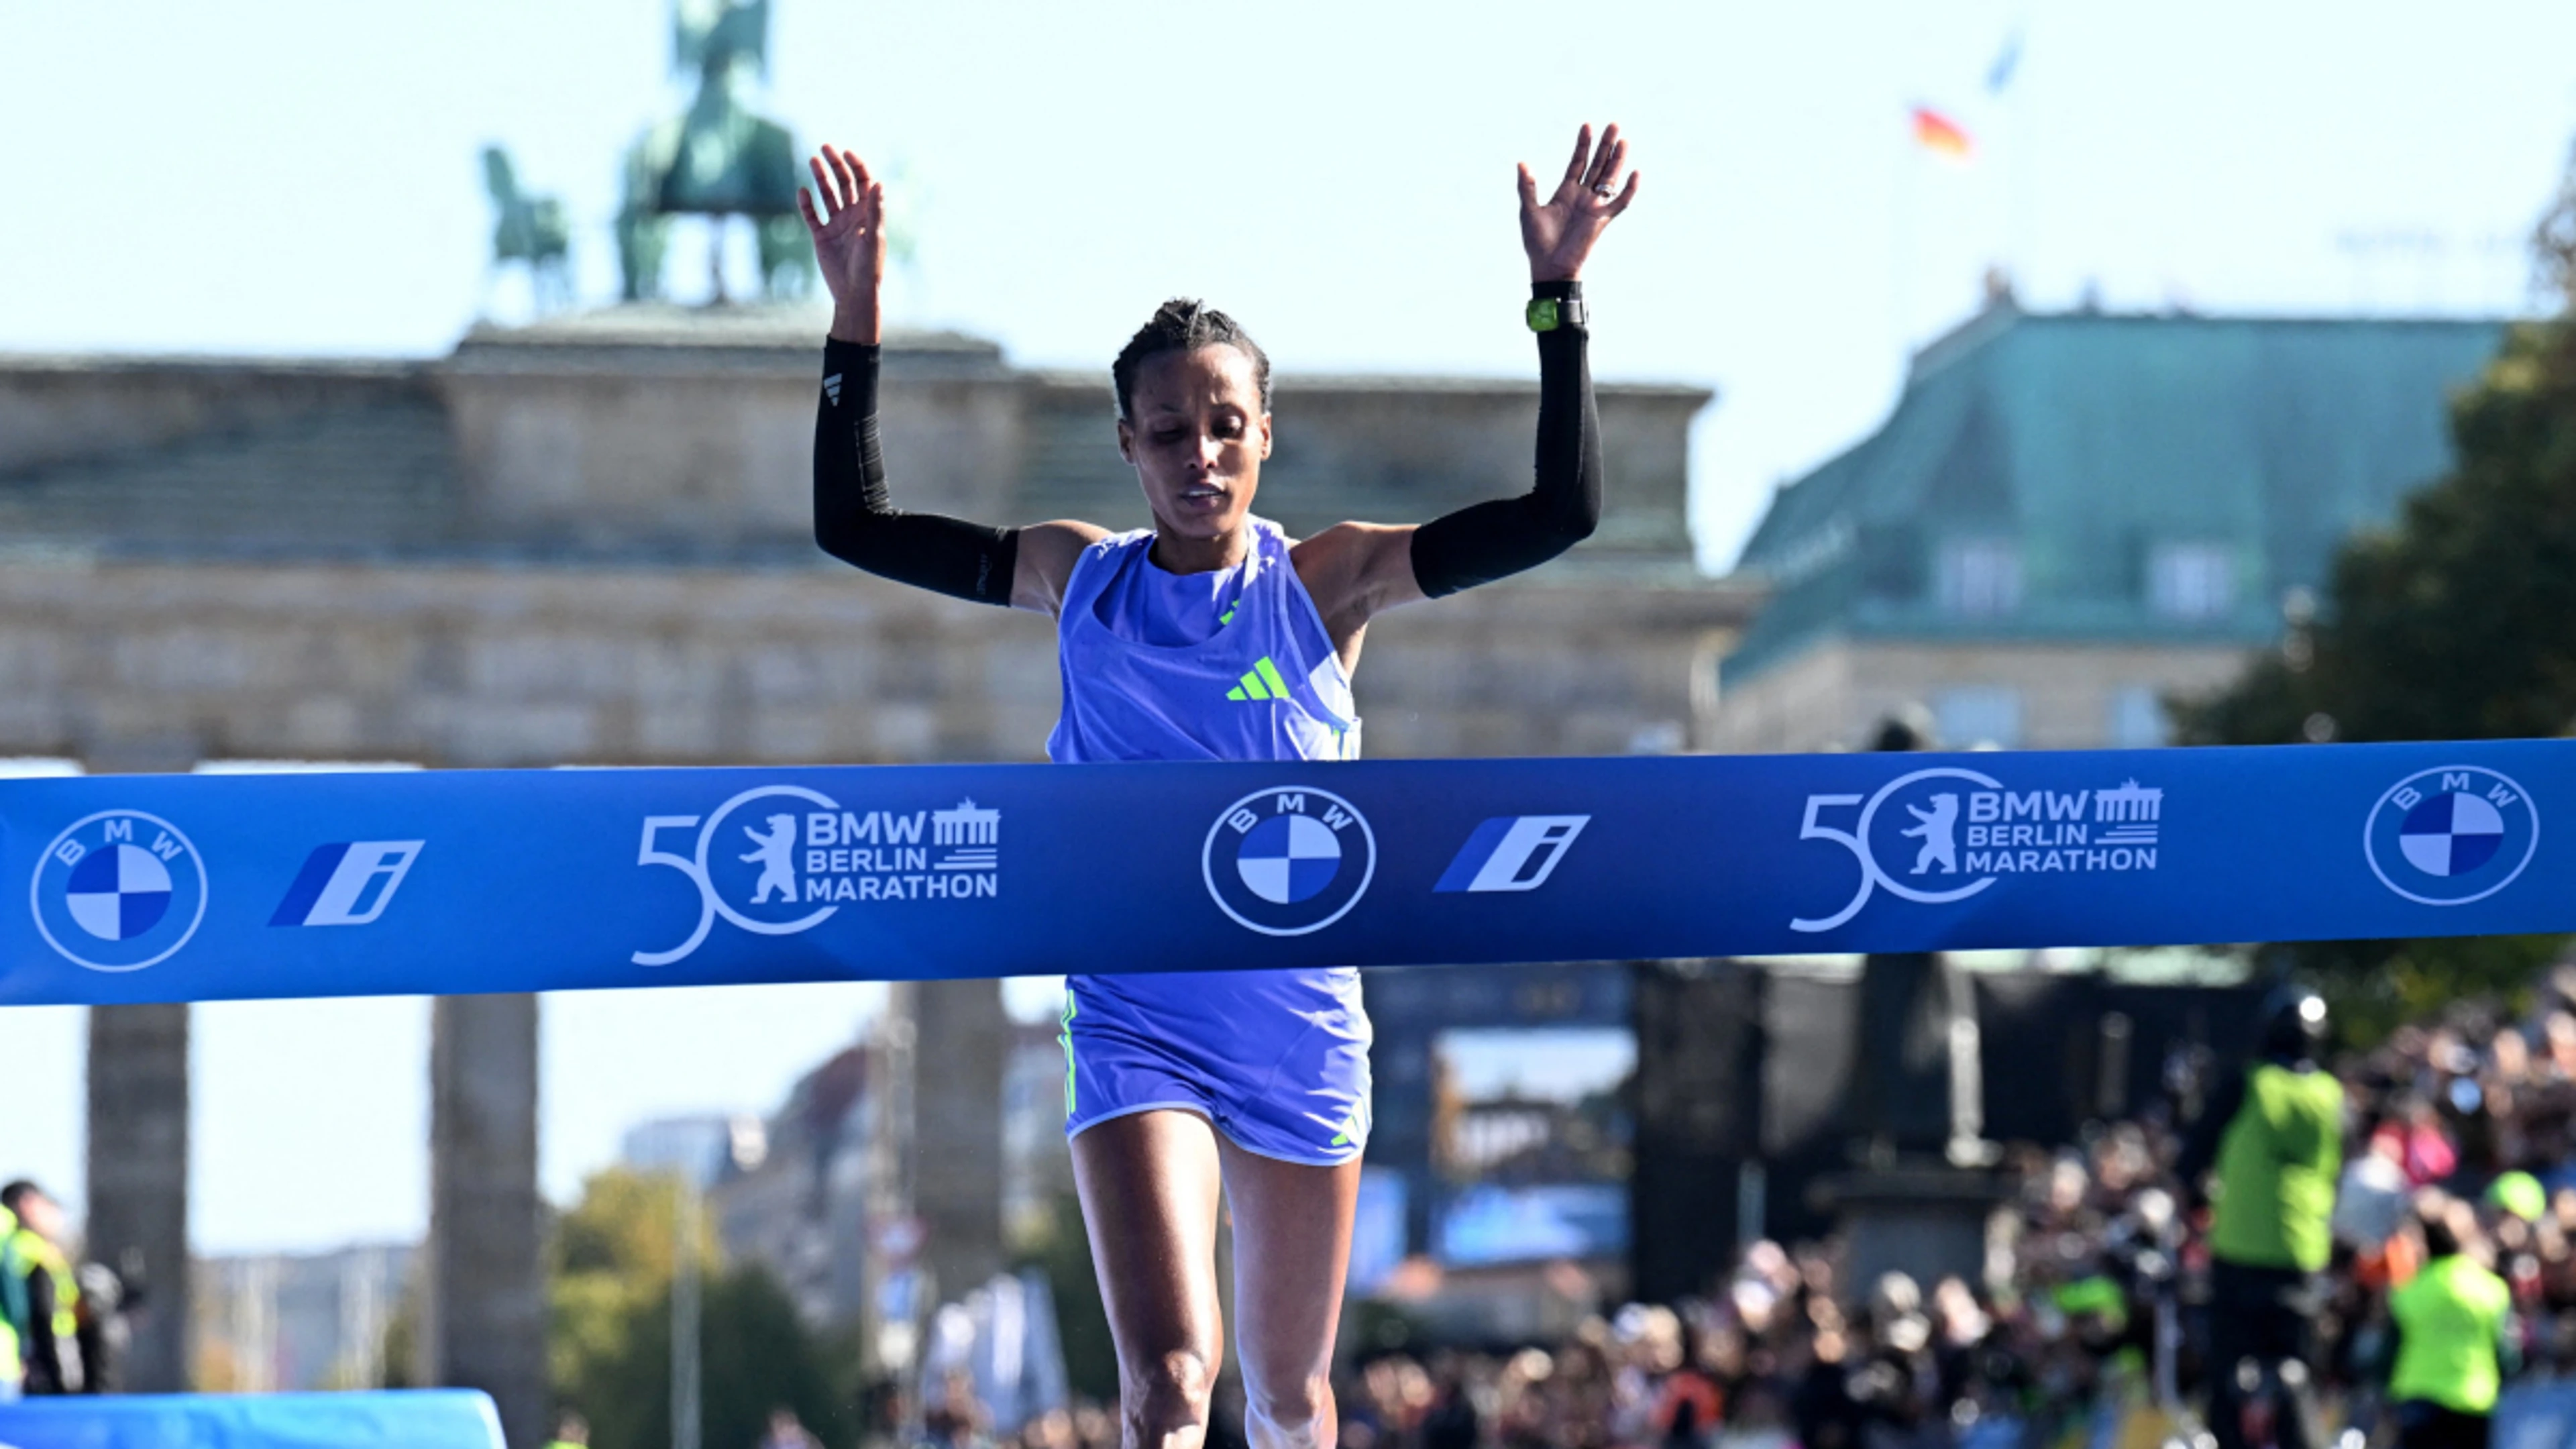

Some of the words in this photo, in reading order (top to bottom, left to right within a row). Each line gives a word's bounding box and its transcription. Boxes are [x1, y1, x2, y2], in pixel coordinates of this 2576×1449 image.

[1968, 790, 2090, 822] BMW
[2390, 772, 2519, 811] BMW
[806, 810, 926, 847] BMW
[1227, 793, 1354, 834] BMW
[55, 818, 184, 867] BMW
[1788, 766, 2004, 933] 50
[1966, 824, 2088, 847] BERLIN
[630, 784, 841, 967] 50
[806, 848, 926, 873] BERLIN
[1965, 848, 2157, 873] MARATHON
[806, 873, 998, 902] MARATHON
